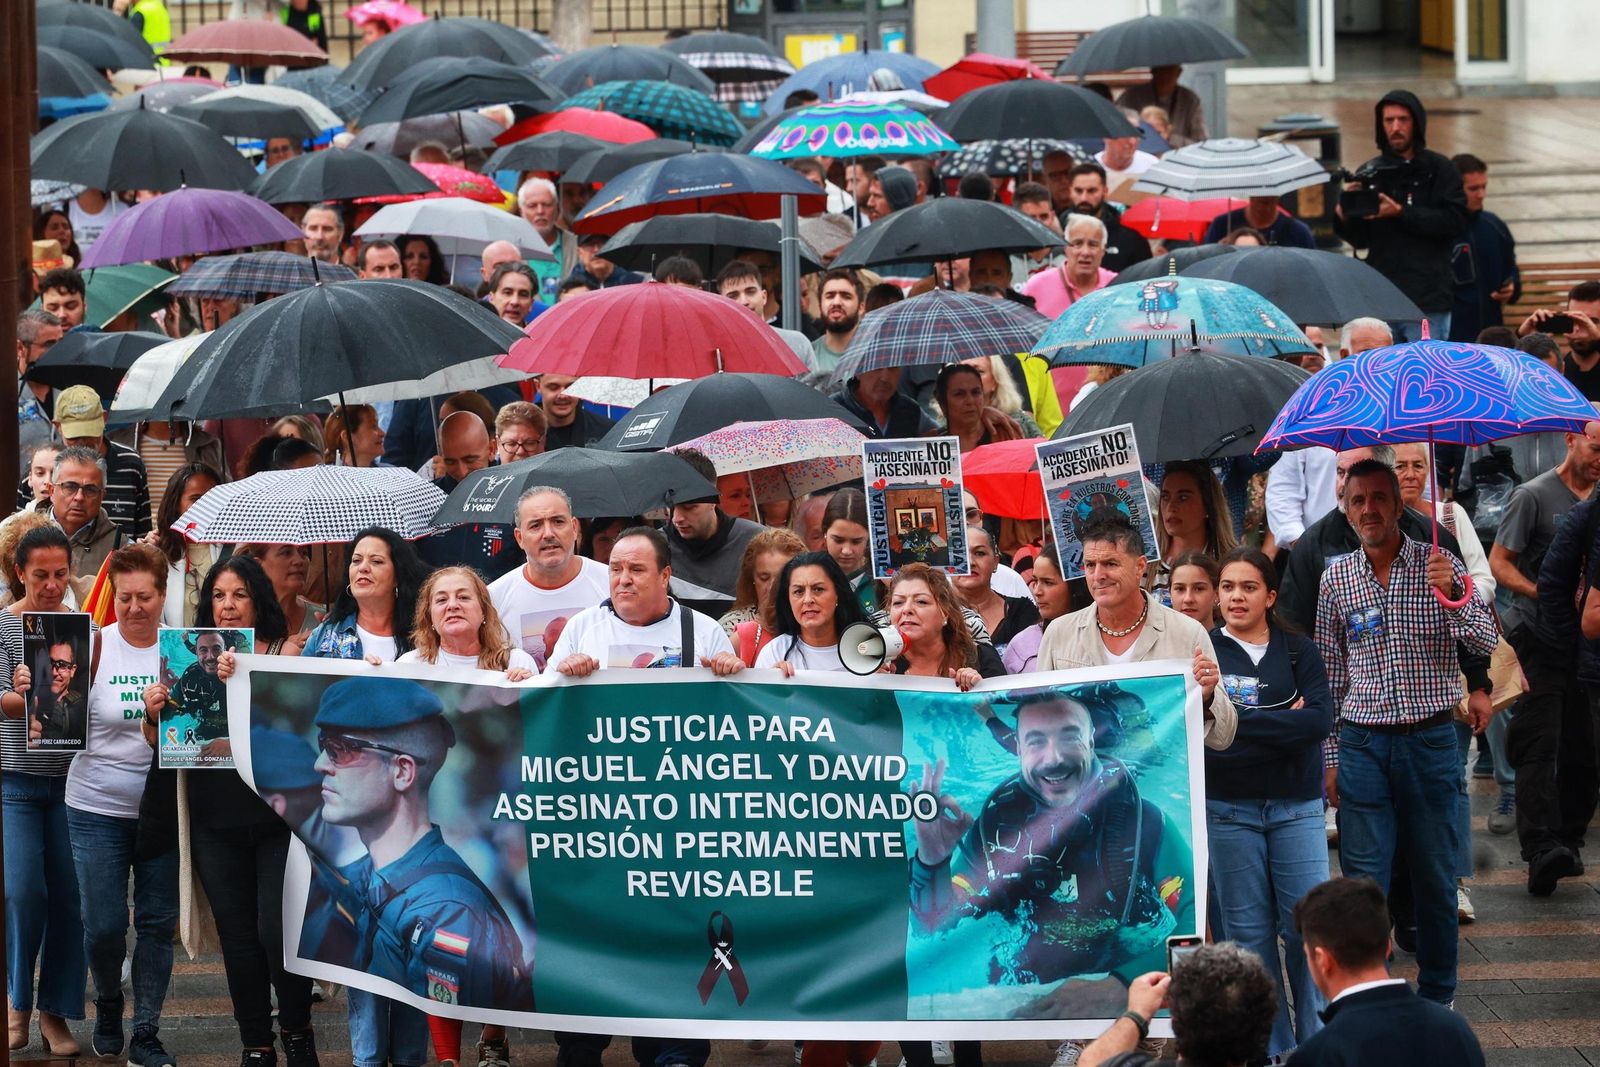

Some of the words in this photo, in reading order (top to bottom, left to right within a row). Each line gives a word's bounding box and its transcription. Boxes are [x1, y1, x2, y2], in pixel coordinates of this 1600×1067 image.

[868, 450, 924, 464] ACCIDENTE
[875, 461, 951, 477] ¡ASESINATO!
[1043, 445, 1100, 468] ACCIDENTE
[1051, 450, 1129, 480] ¡ASESINATO!
[1066, 496, 1078, 509] EN
[1075, 482, 1116, 501] NUESTROS
[872, 491, 890, 569] JUSTICIA
[948, 488, 965, 569] JUSTICIA
[1062, 508, 1077, 544] SIEMPRE
[587, 714, 741, 744] JUSTICIA
[748, 714, 836, 742] PARA
[521, 755, 646, 783] MIGUEL
[655, 747, 772, 782] ÁNGEL
[779, 754, 799, 780] Y
[808, 754, 907, 783] DAVID
[493, 793, 678, 821] ASESINATO
[690, 792, 938, 821] INTENCIONADO
[531, 825, 663, 859] PRISIÓN
[675, 831, 904, 858] PERMANENTE
[627, 870, 814, 897] REVISABLE
